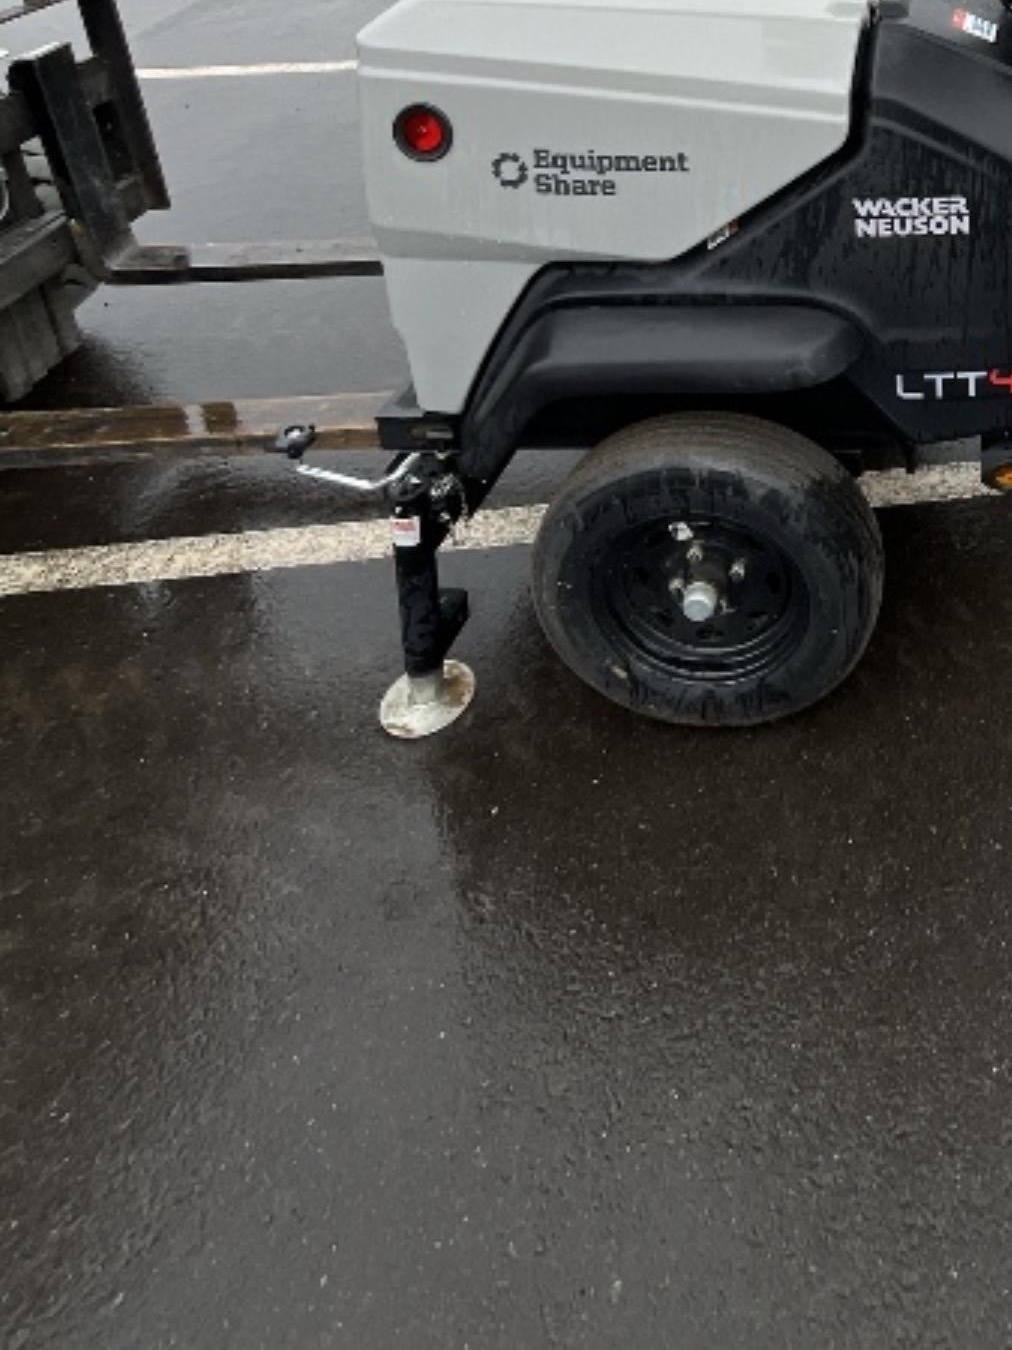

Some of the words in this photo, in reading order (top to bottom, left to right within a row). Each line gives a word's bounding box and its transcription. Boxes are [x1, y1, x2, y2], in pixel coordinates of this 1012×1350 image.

[533, 149, 690, 175] Equipment
[534, 173, 617, 196] Share
[852, 196, 970, 217] WACKER
[854, 215, 970, 238] NEUSON
